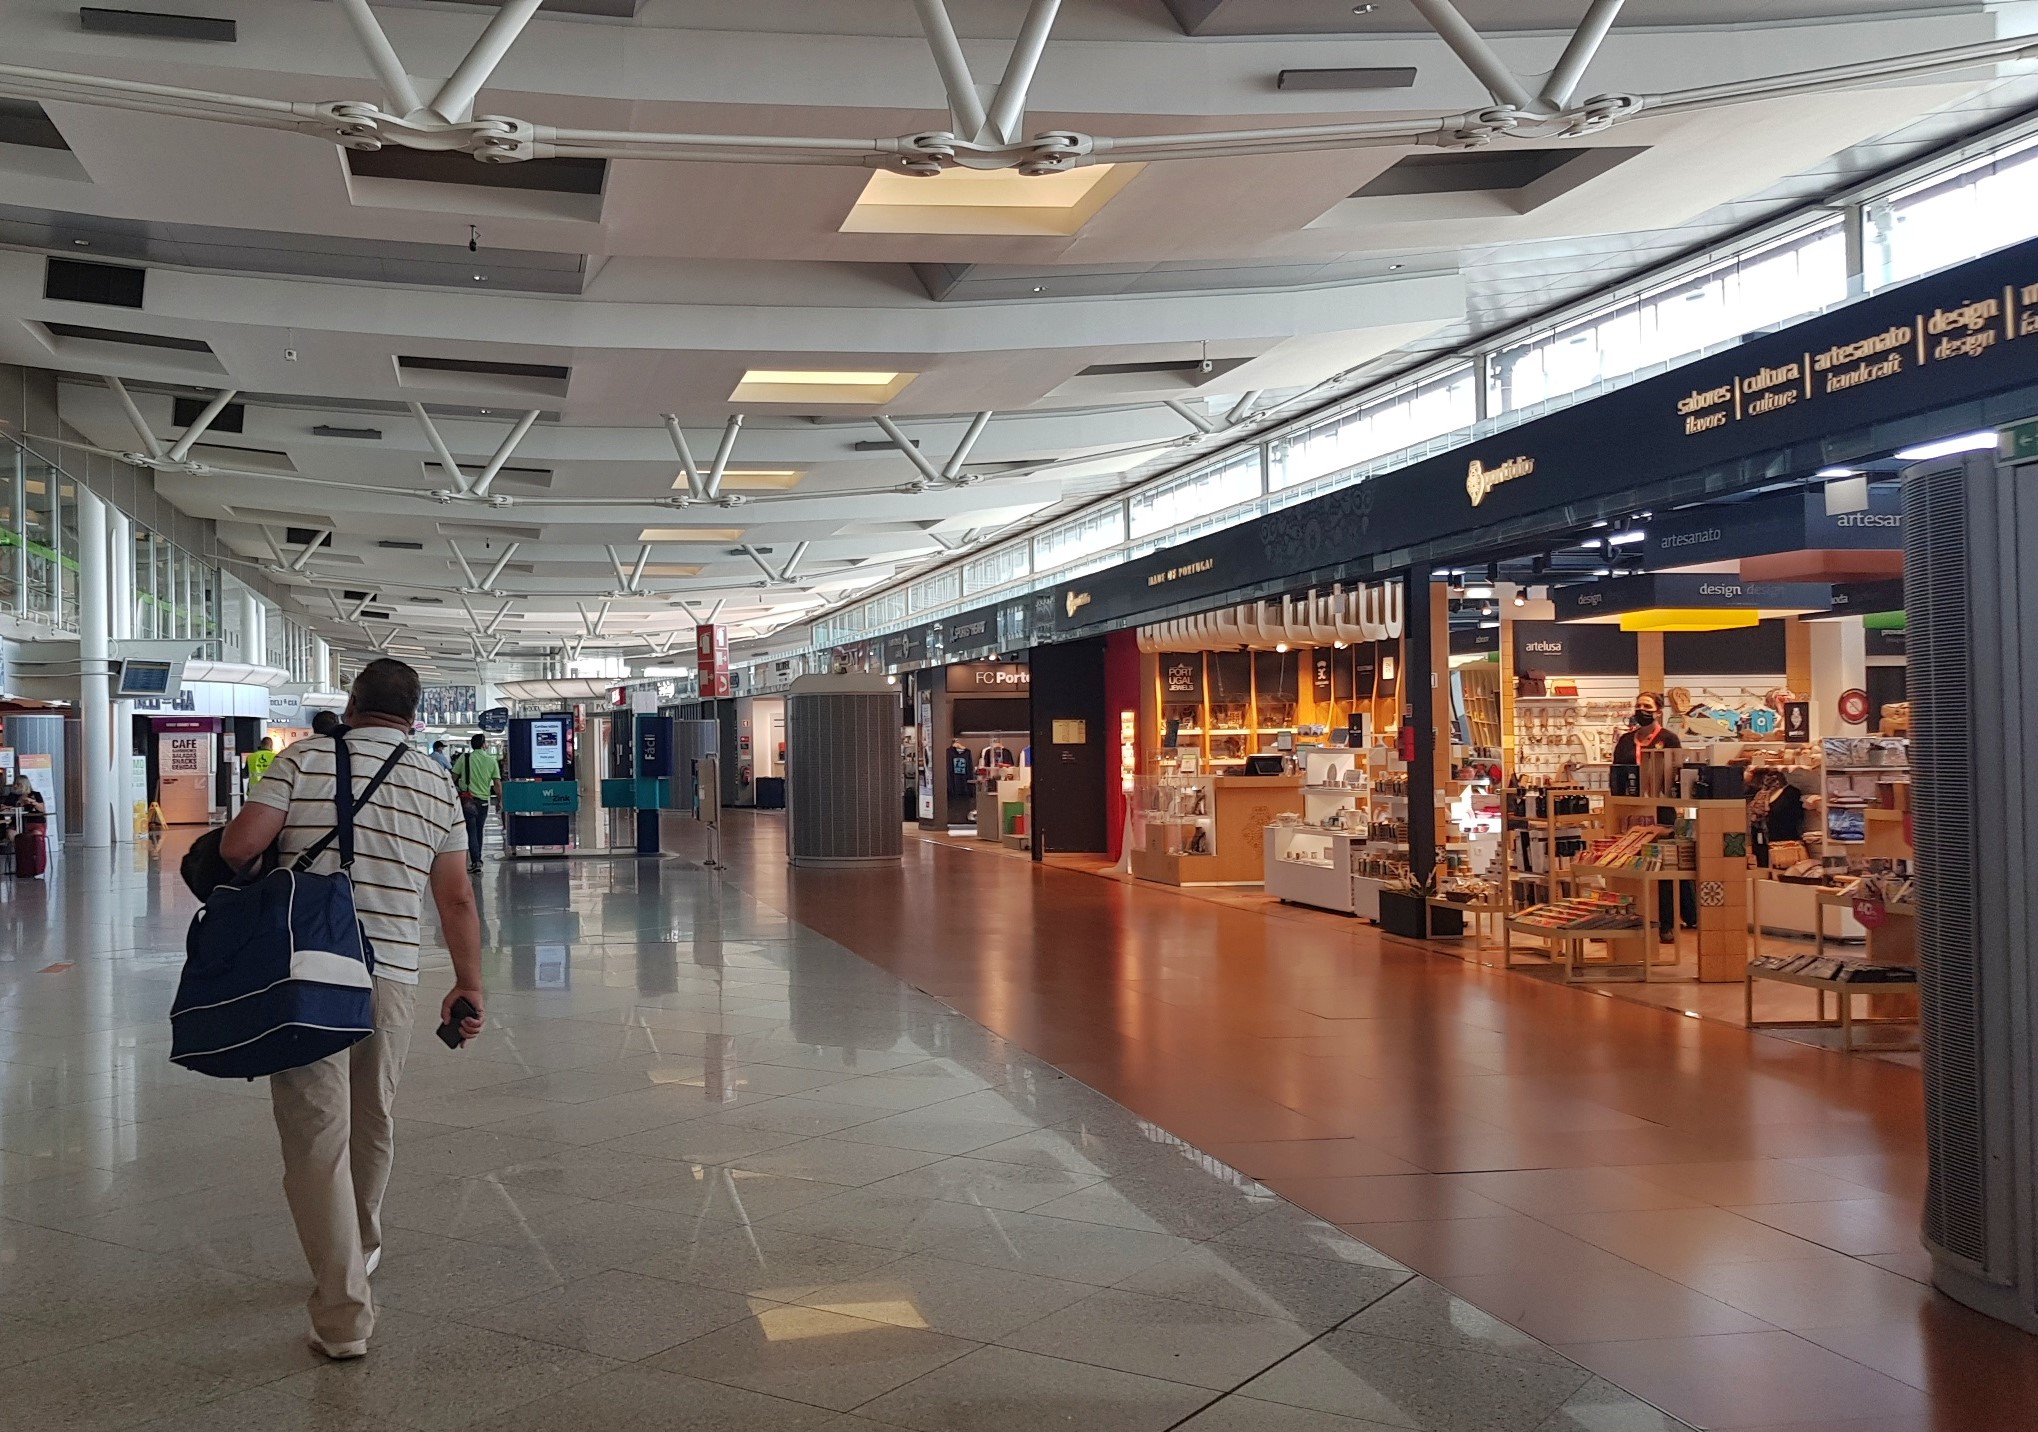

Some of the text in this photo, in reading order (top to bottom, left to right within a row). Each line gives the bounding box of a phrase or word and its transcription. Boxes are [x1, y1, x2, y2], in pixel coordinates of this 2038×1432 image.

[1677, 385, 1731, 415] sabores
[1742, 363, 1800, 393] cultura
[1814, 326, 1912, 371] artesanato
[1927, 298, 2000, 334] design
[1685, 411, 1727, 435] flavors
[1748, 389, 1797, 416] culture
[1826, 352, 1903, 393] handcraft
[1934, 330, 1996, 357] design
[1661, 528, 1721, 549] artesanato
[1700, 583, 1742, 598] design
[1578, 593, 1602, 606] design
[1525, 640, 1562, 652] artelusa
[976, 671, 995, 684] FC
[1168, 668, 1192, 677] PORT
[1168, 677, 1194, 685] UGAL
